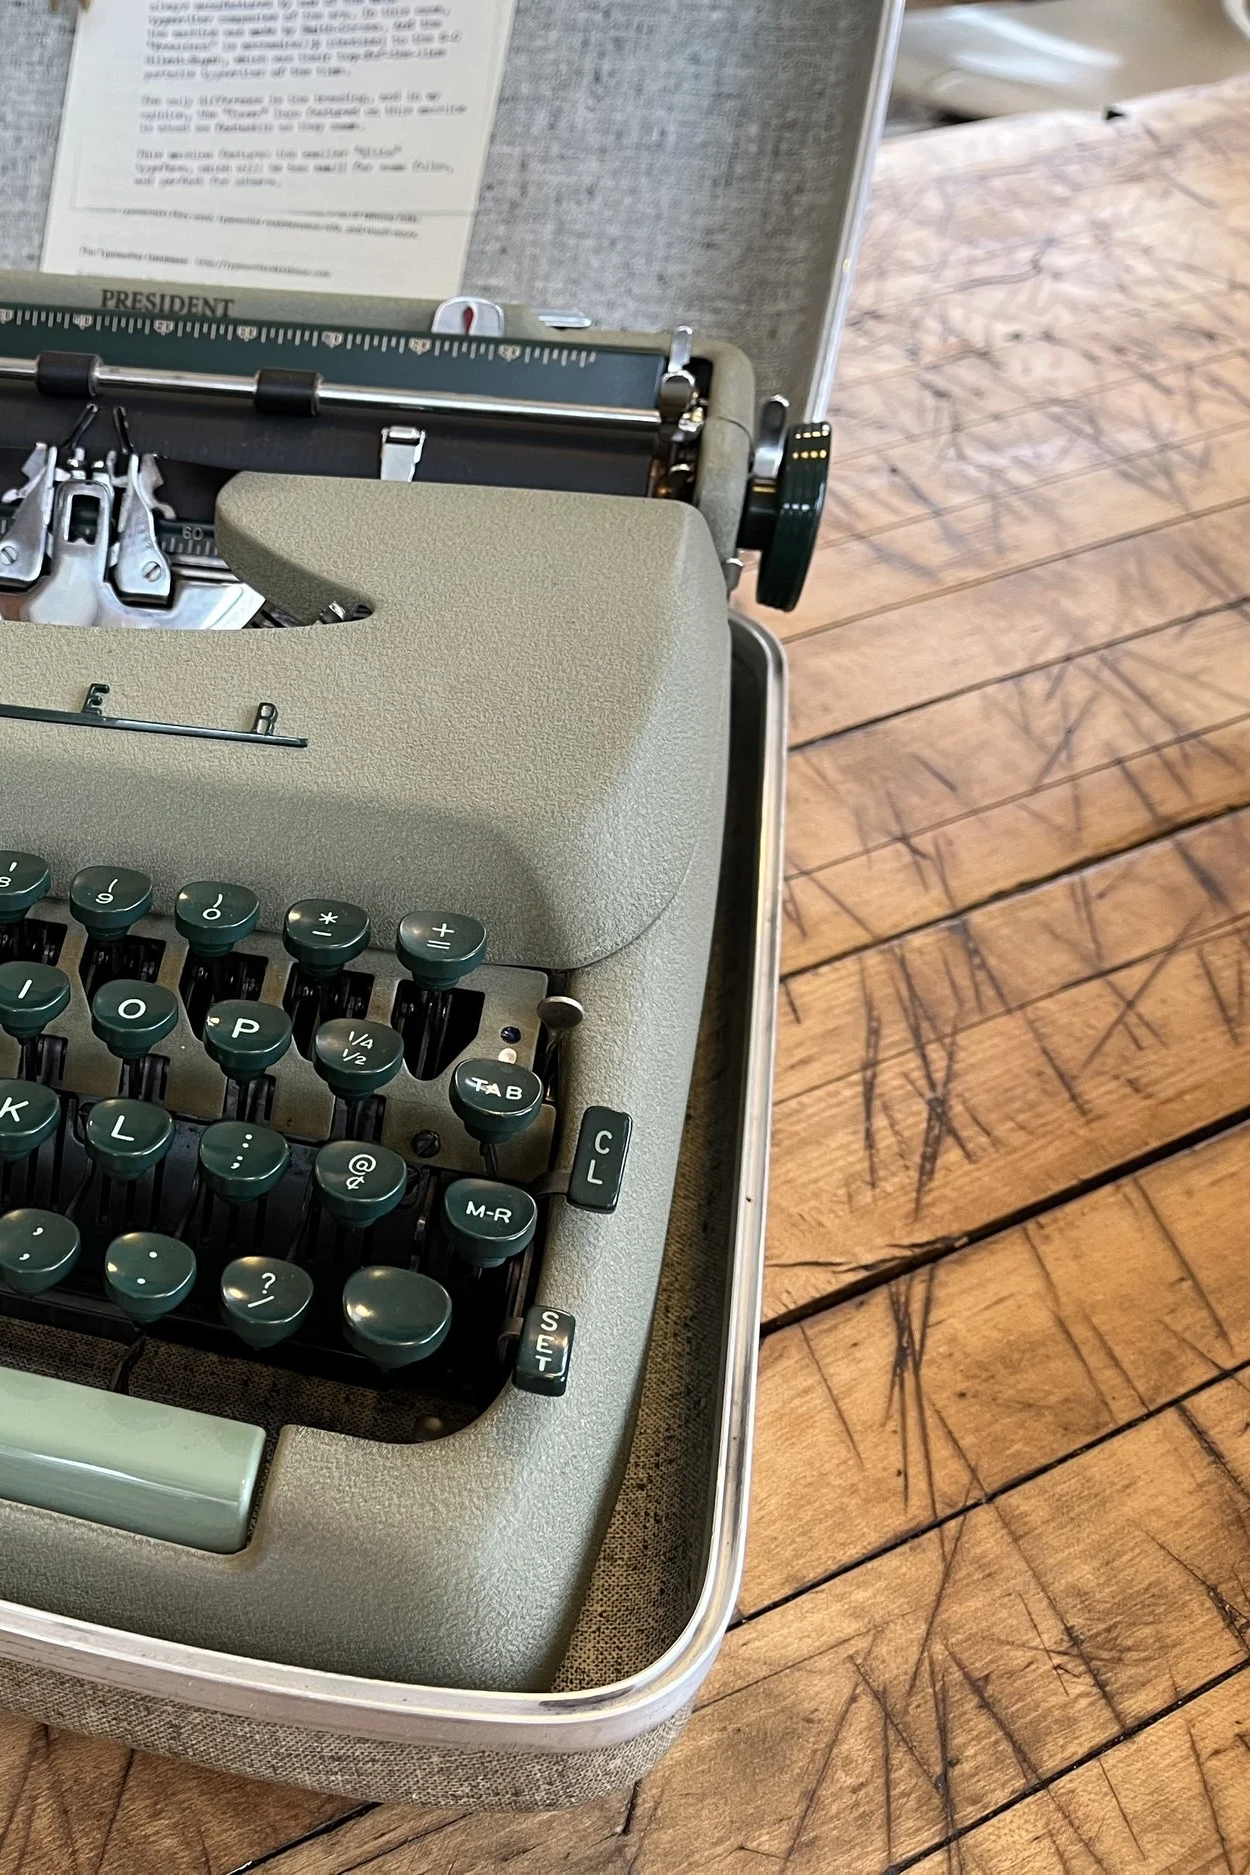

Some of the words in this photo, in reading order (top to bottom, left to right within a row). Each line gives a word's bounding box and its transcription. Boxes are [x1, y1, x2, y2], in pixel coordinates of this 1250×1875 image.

[101, 289, 236, 318] PRESIDENT
[182, 526, 204, 540] 60
[96, 891, 113, 903] 9
[232, 1018, 259, 1038] P
[469, 1077, 522, 1099] TAB
[111, 1115, 134, 1141] L
[466, 1201, 511, 1223] M-R
[262, 1273, 275, 1294] ?
[535, 1309, 561, 1374] SET
